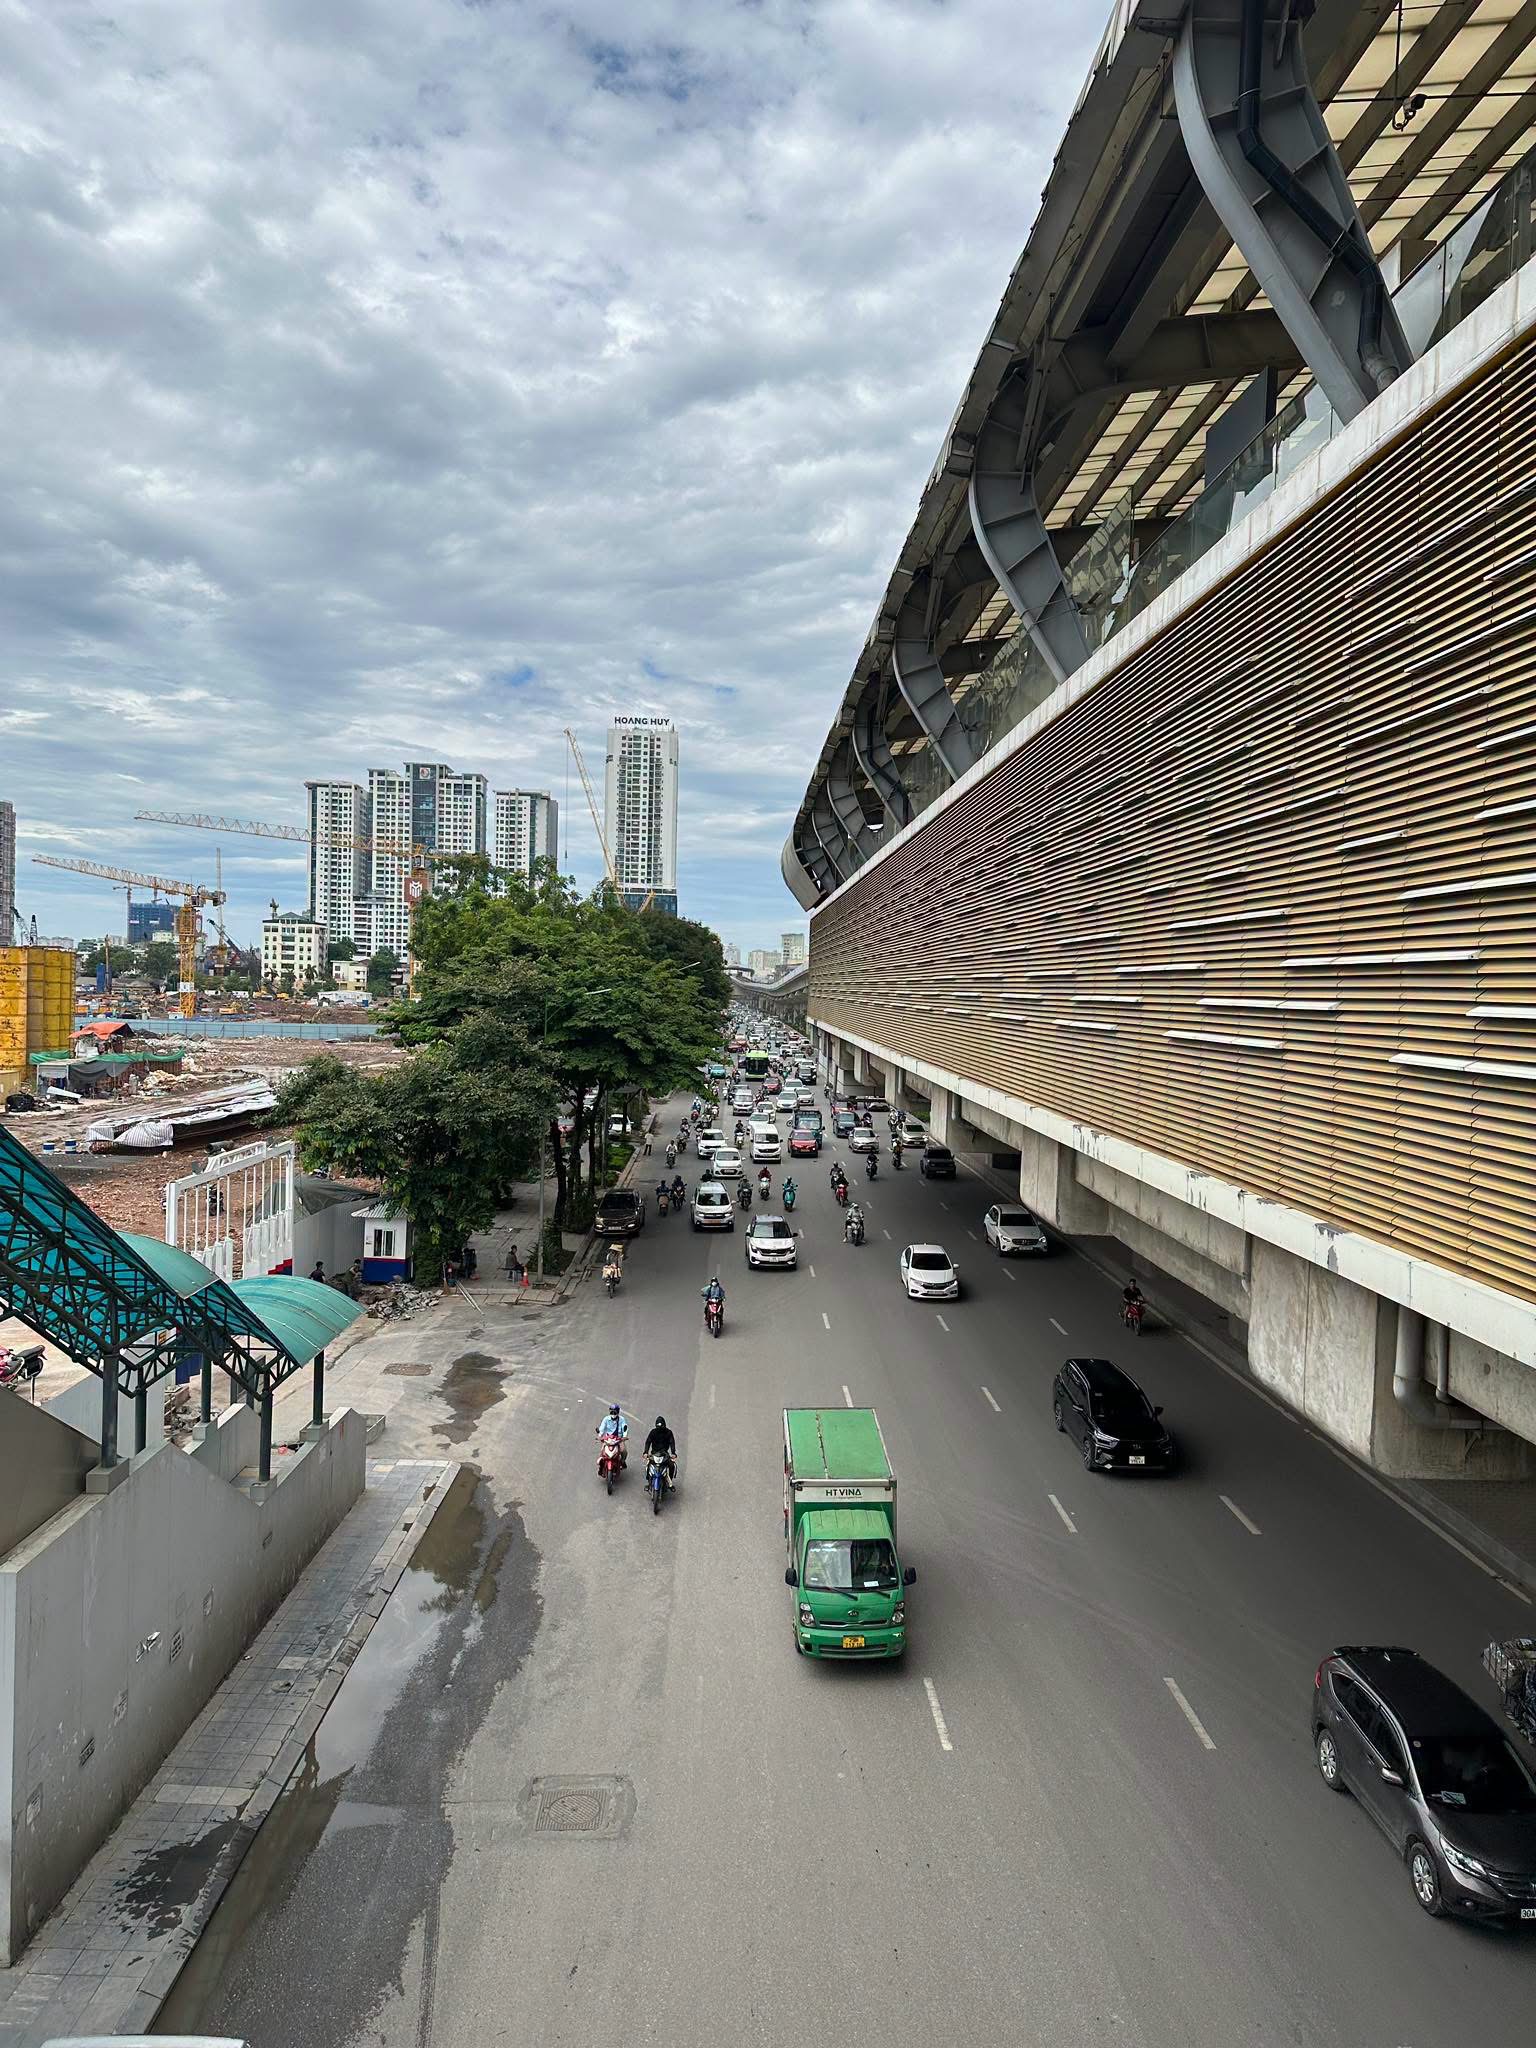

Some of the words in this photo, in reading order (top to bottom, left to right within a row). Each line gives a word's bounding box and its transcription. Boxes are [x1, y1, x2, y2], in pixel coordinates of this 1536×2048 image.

[614, 716, 648, 725] HOANG
[650, 718, 670, 726] HUY
[839, 1488, 862, 1496] VINA
[1522, 1909, 1536, 1918] 30A
